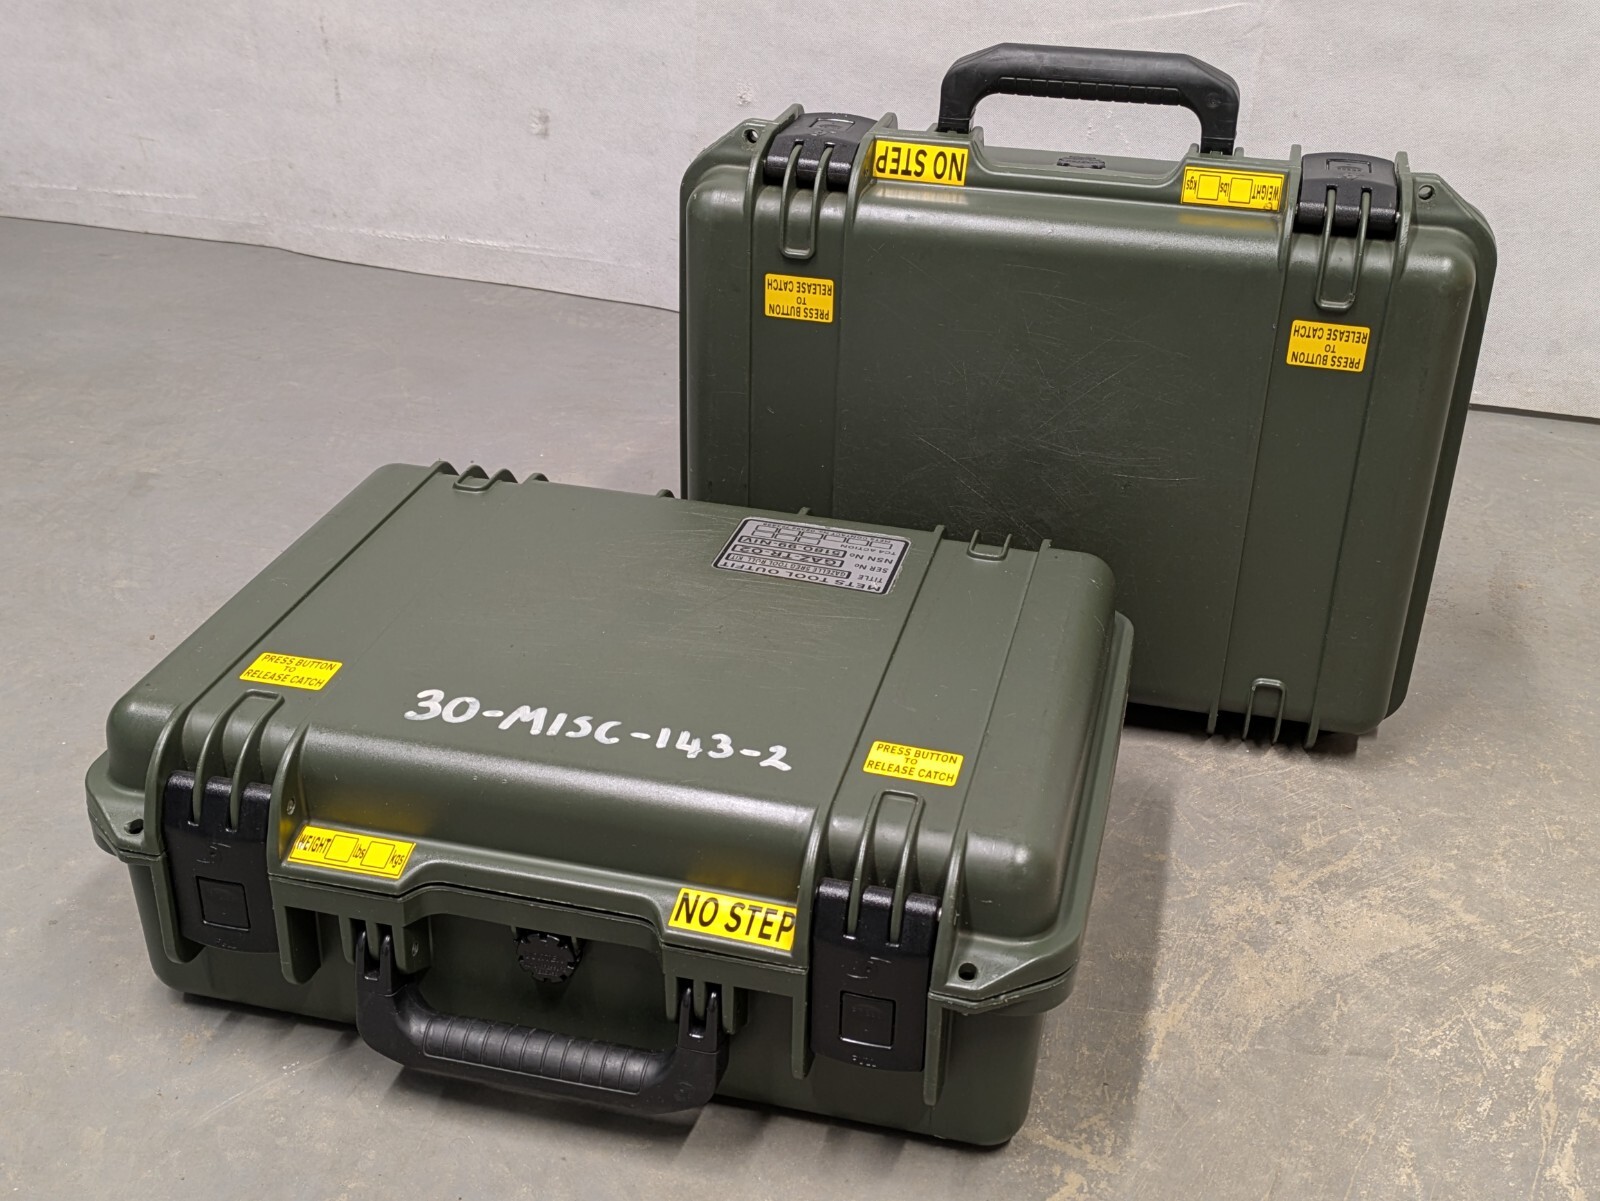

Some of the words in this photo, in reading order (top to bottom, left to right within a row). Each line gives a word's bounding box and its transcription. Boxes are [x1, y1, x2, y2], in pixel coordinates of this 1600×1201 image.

[876, 146, 928, 177] STEP
[933, 151, 965, 181] NO
[1186, 176, 1197, 194] kgs
[1220, 182, 1230, 197] lbs
[1252, 184, 1280, 201] WEIGHT
[767, 278, 794, 292] CATCH
[796, 281, 833, 296] RELEASE
[796, 297, 807, 305] TO
[769, 304, 801, 317] BUTTON
[803, 307, 830, 320] PRESS
[1293, 325, 1324, 339] CATCH
[1326, 328, 1368, 344] RELEASE
[1324, 344, 1336, 353] TO
[1291, 351, 1329, 365] BUTTON
[1330, 355, 1361, 369] PRESS
[832, 532, 868, 540] CONTACT
[840, 544, 877, 552] ACTION
[740, 546, 836, 565] GAZ-TR-02
[867, 555, 893, 564] NSN
[720, 561, 779, 574] OUTFIT
[813, 567, 846, 577] GAZELLE
[869, 566, 889, 574] SER
[785, 570, 828, 583] TOOL
[858, 574, 883, 583] TITLE
[835, 580, 881, 591] METS
[262, 654, 295, 664] PRESS
[295, 659, 337, 671] BUTTON
[243, 669, 290, 682] RELEASE
[290, 675, 325, 687] CATCH
[404, 688, 792, 771] 30-MISC-143-2
[876, 743, 912, 756] PRESS
[914, 750, 958, 764] BUTTON
[904, 757, 918, 765] TO
[866, 760, 915, 776] RELEASE
[918, 768, 955, 783] CATCH
[297, 834, 332, 853] WEIGHT
[352, 843, 366, 859] lbs
[390, 849, 405, 868] kgs
[674, 892, 719, 927] NO
[723, 902, 796, 942] STEP
